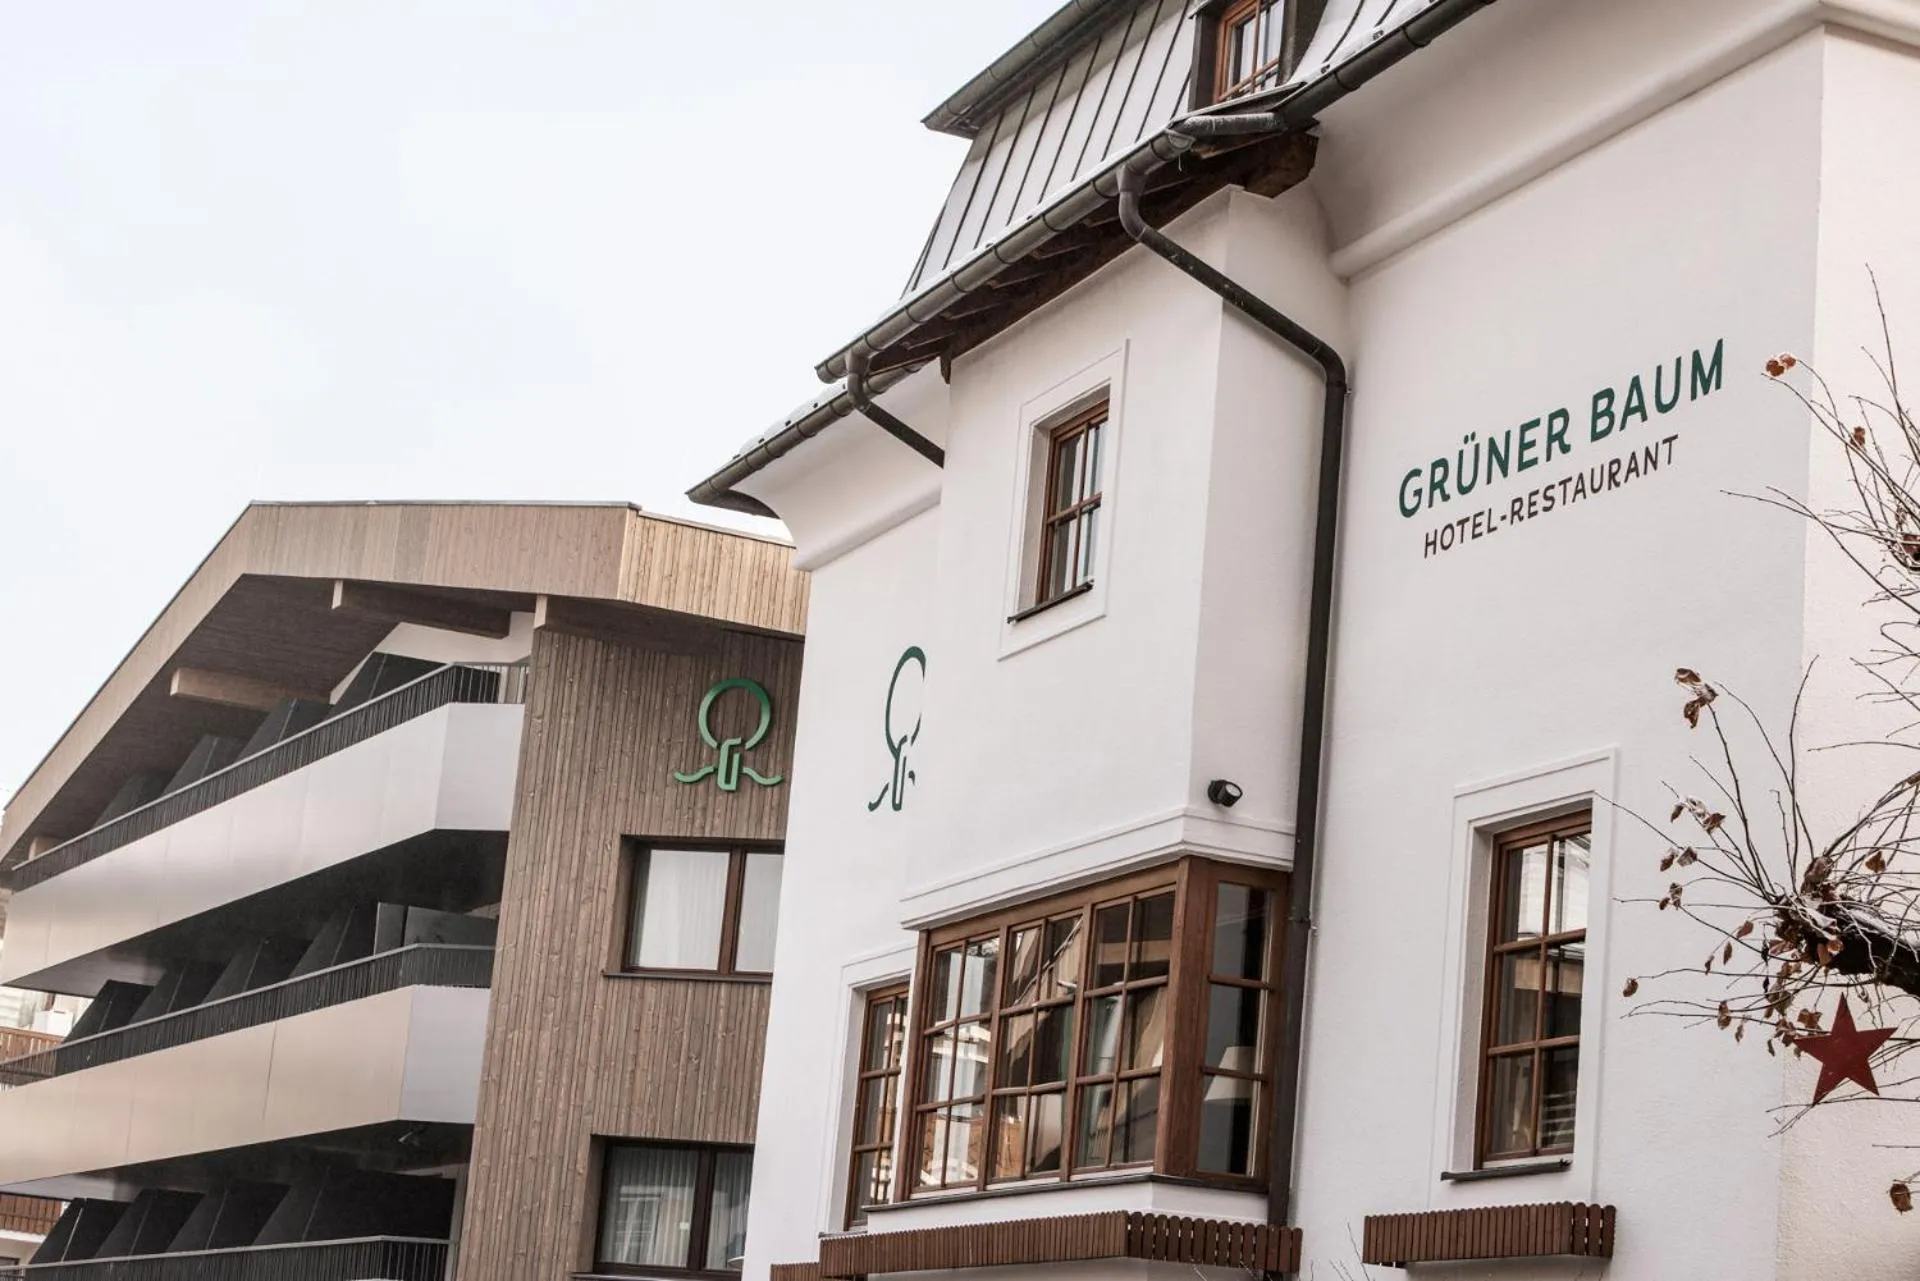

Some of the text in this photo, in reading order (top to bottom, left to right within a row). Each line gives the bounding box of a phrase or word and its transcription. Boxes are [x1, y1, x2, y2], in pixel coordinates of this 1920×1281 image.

[1398, 338, 1724, 519] GRÜNER BAUM
[1424, 434, 1679, 559] HOTEL-RESTAURANT
